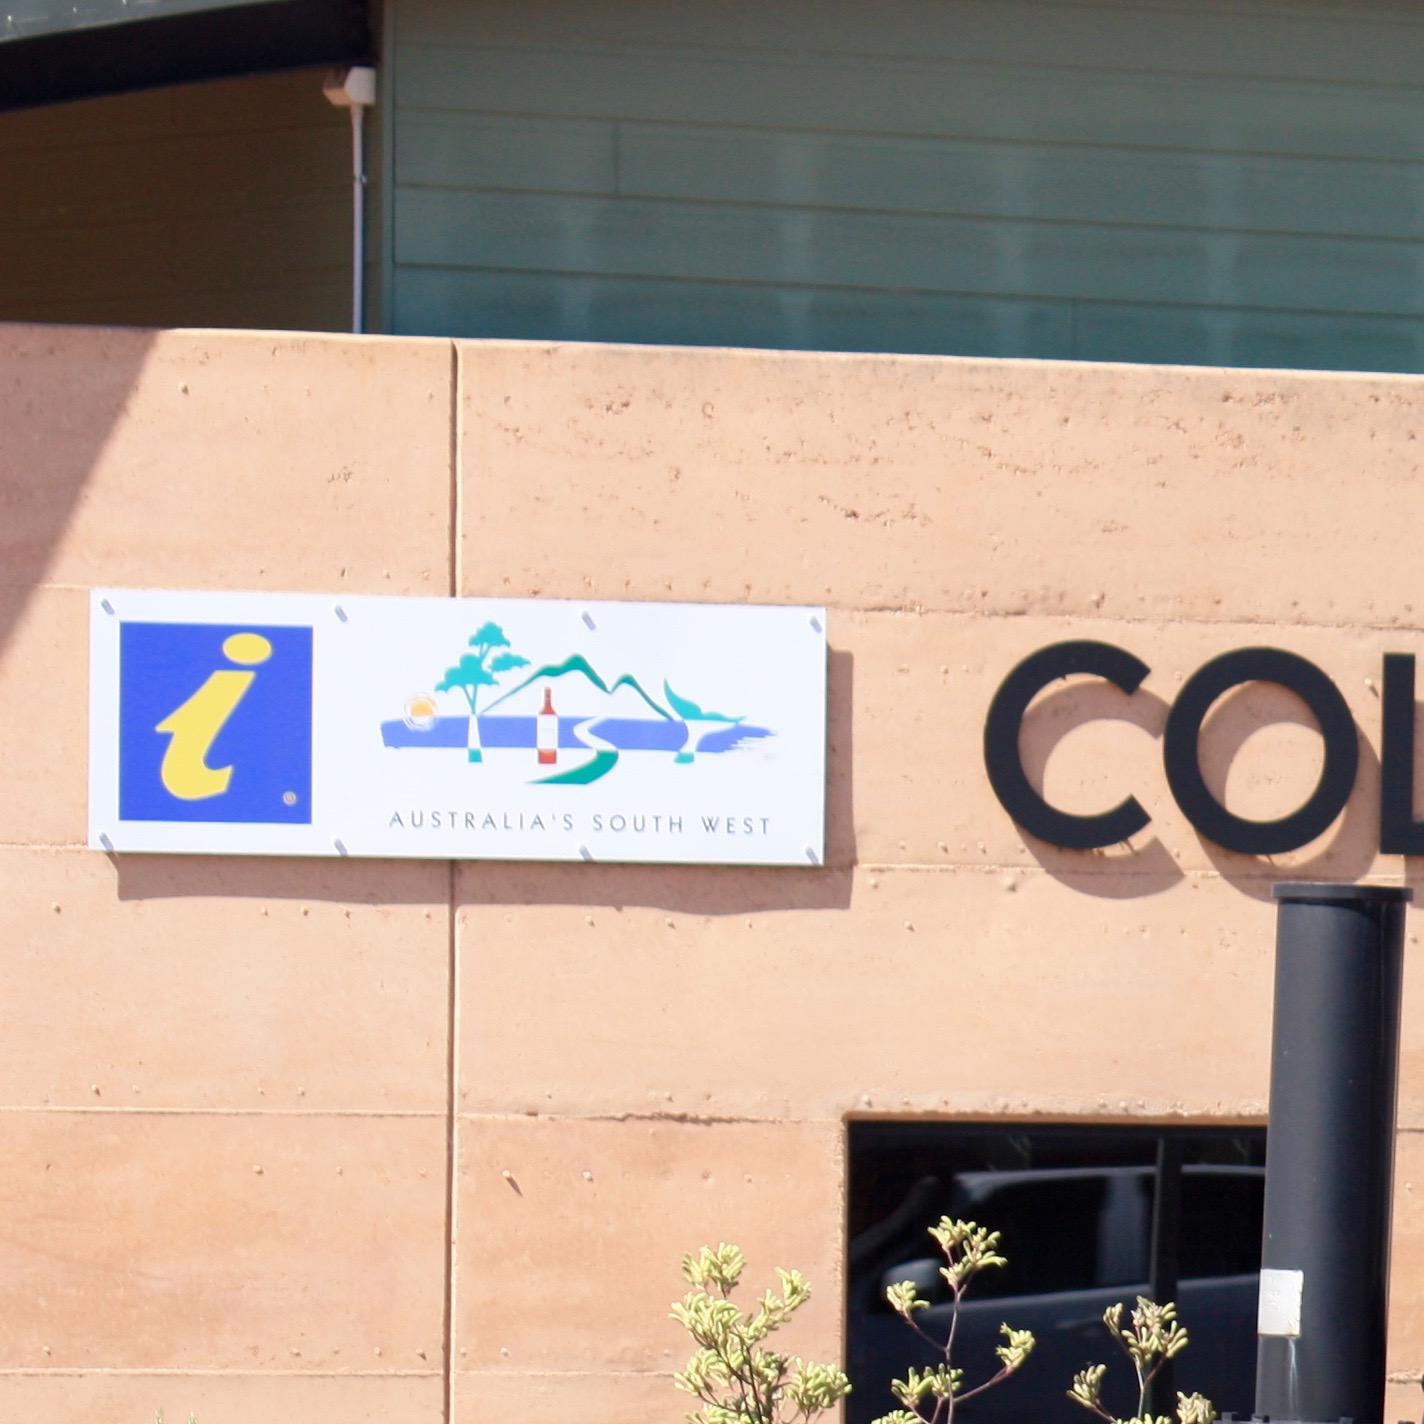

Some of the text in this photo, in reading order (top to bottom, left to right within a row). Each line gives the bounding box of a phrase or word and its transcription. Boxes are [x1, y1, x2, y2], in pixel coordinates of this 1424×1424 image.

[389, 810, 771, 836] AUSTRALIA'S SOUTH WEST
